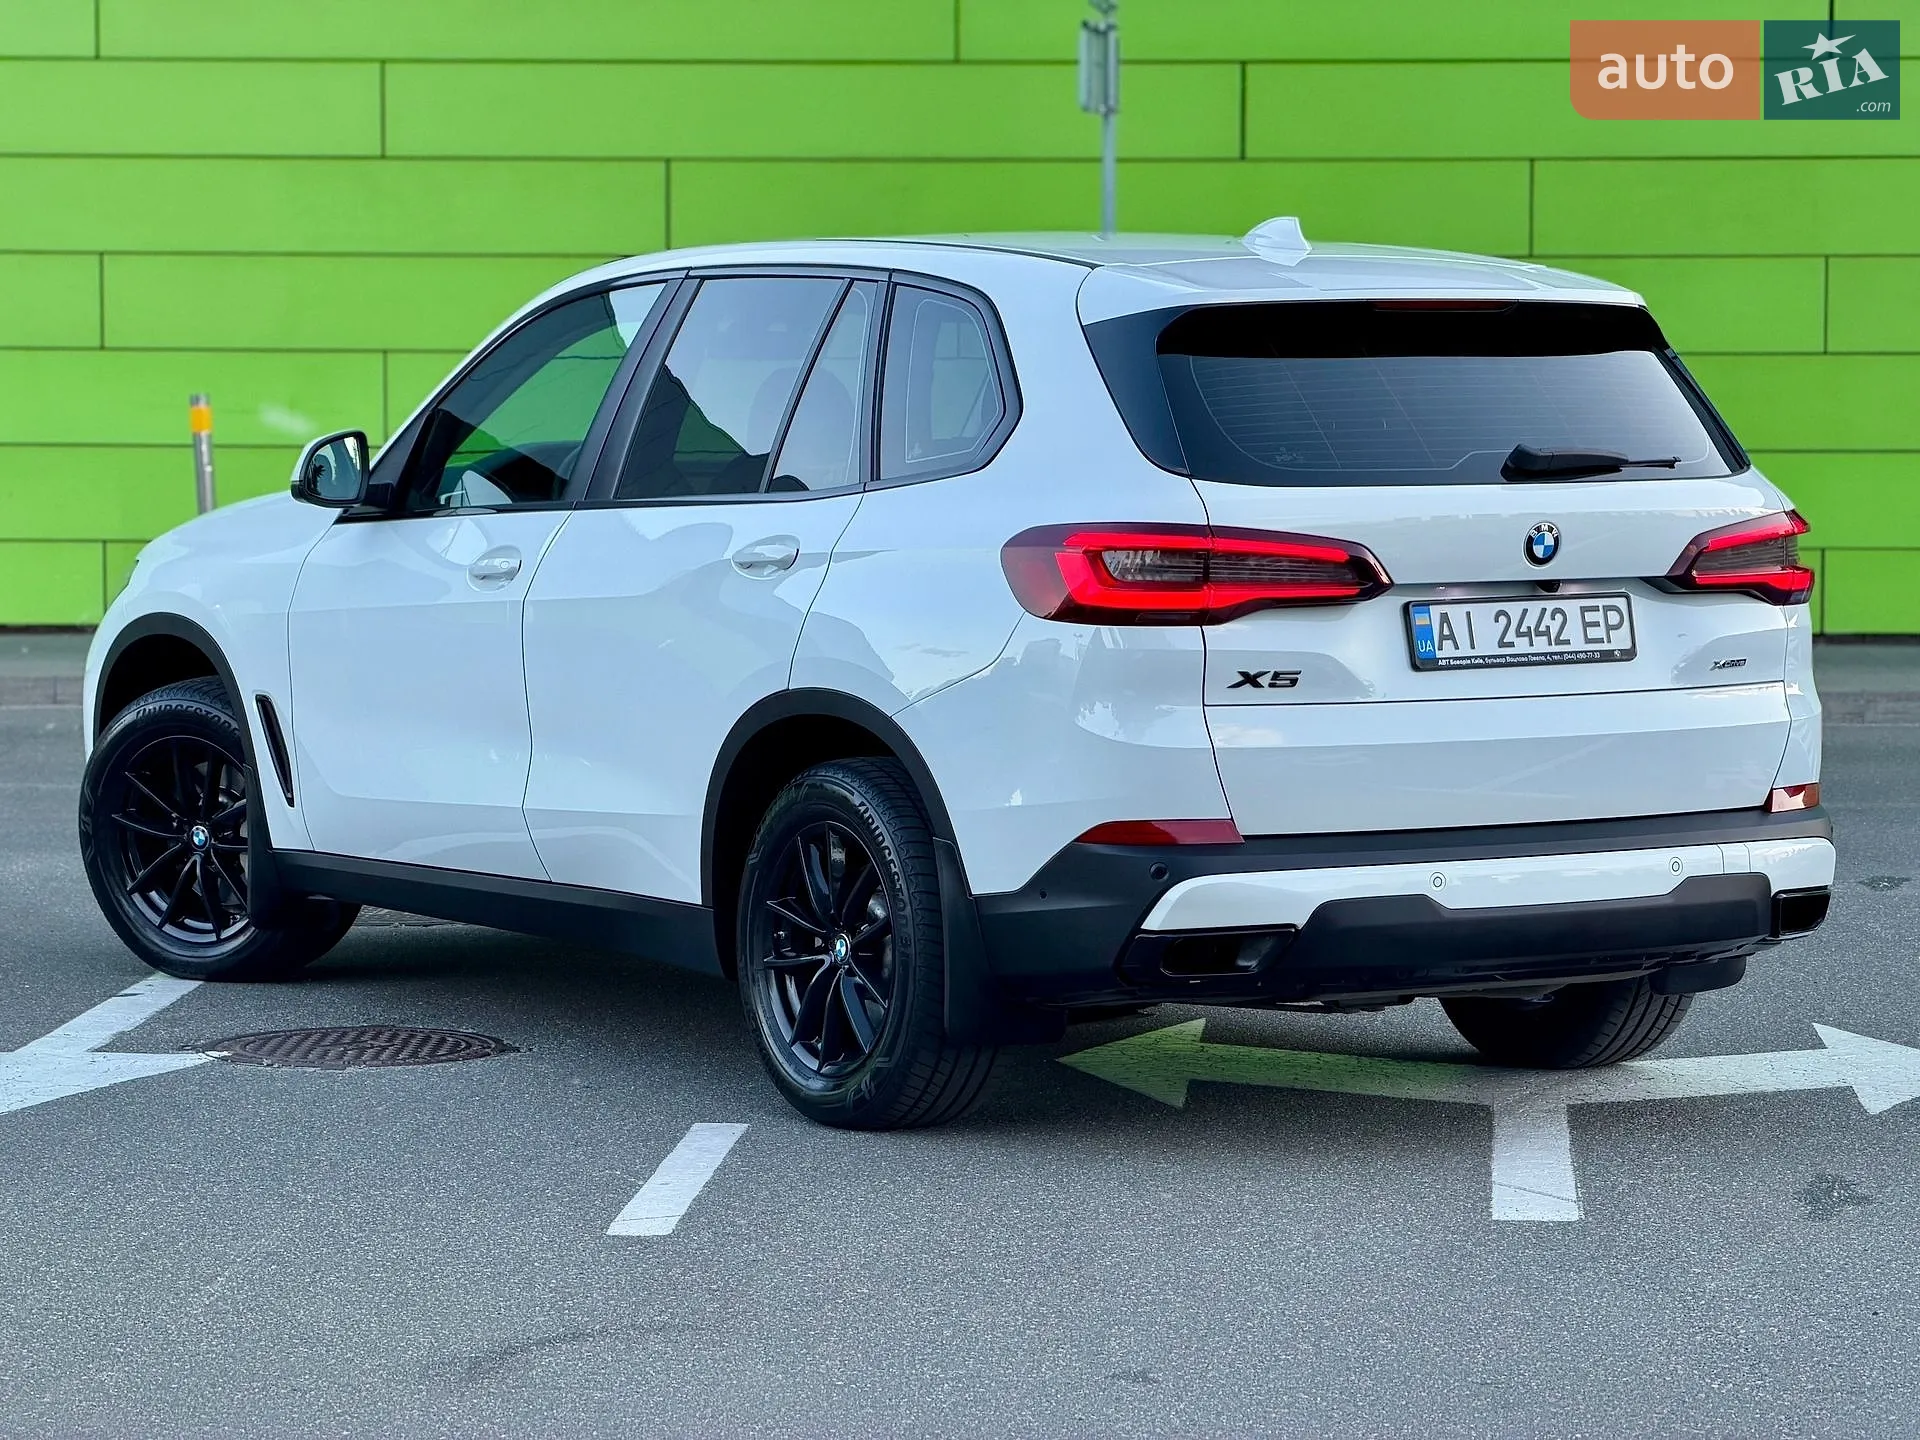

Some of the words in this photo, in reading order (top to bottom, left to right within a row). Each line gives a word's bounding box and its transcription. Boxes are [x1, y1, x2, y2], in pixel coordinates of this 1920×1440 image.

[1530, 524, 1559, 538] BMW
[1437, 610, 1476, 652] AI
[1494, 607, 1572, 649] 2442
[1580, 604, 1625, 645] EP
[1417, 639, 1434, 653] UA
[1226, 670, 1302, 688] X5
